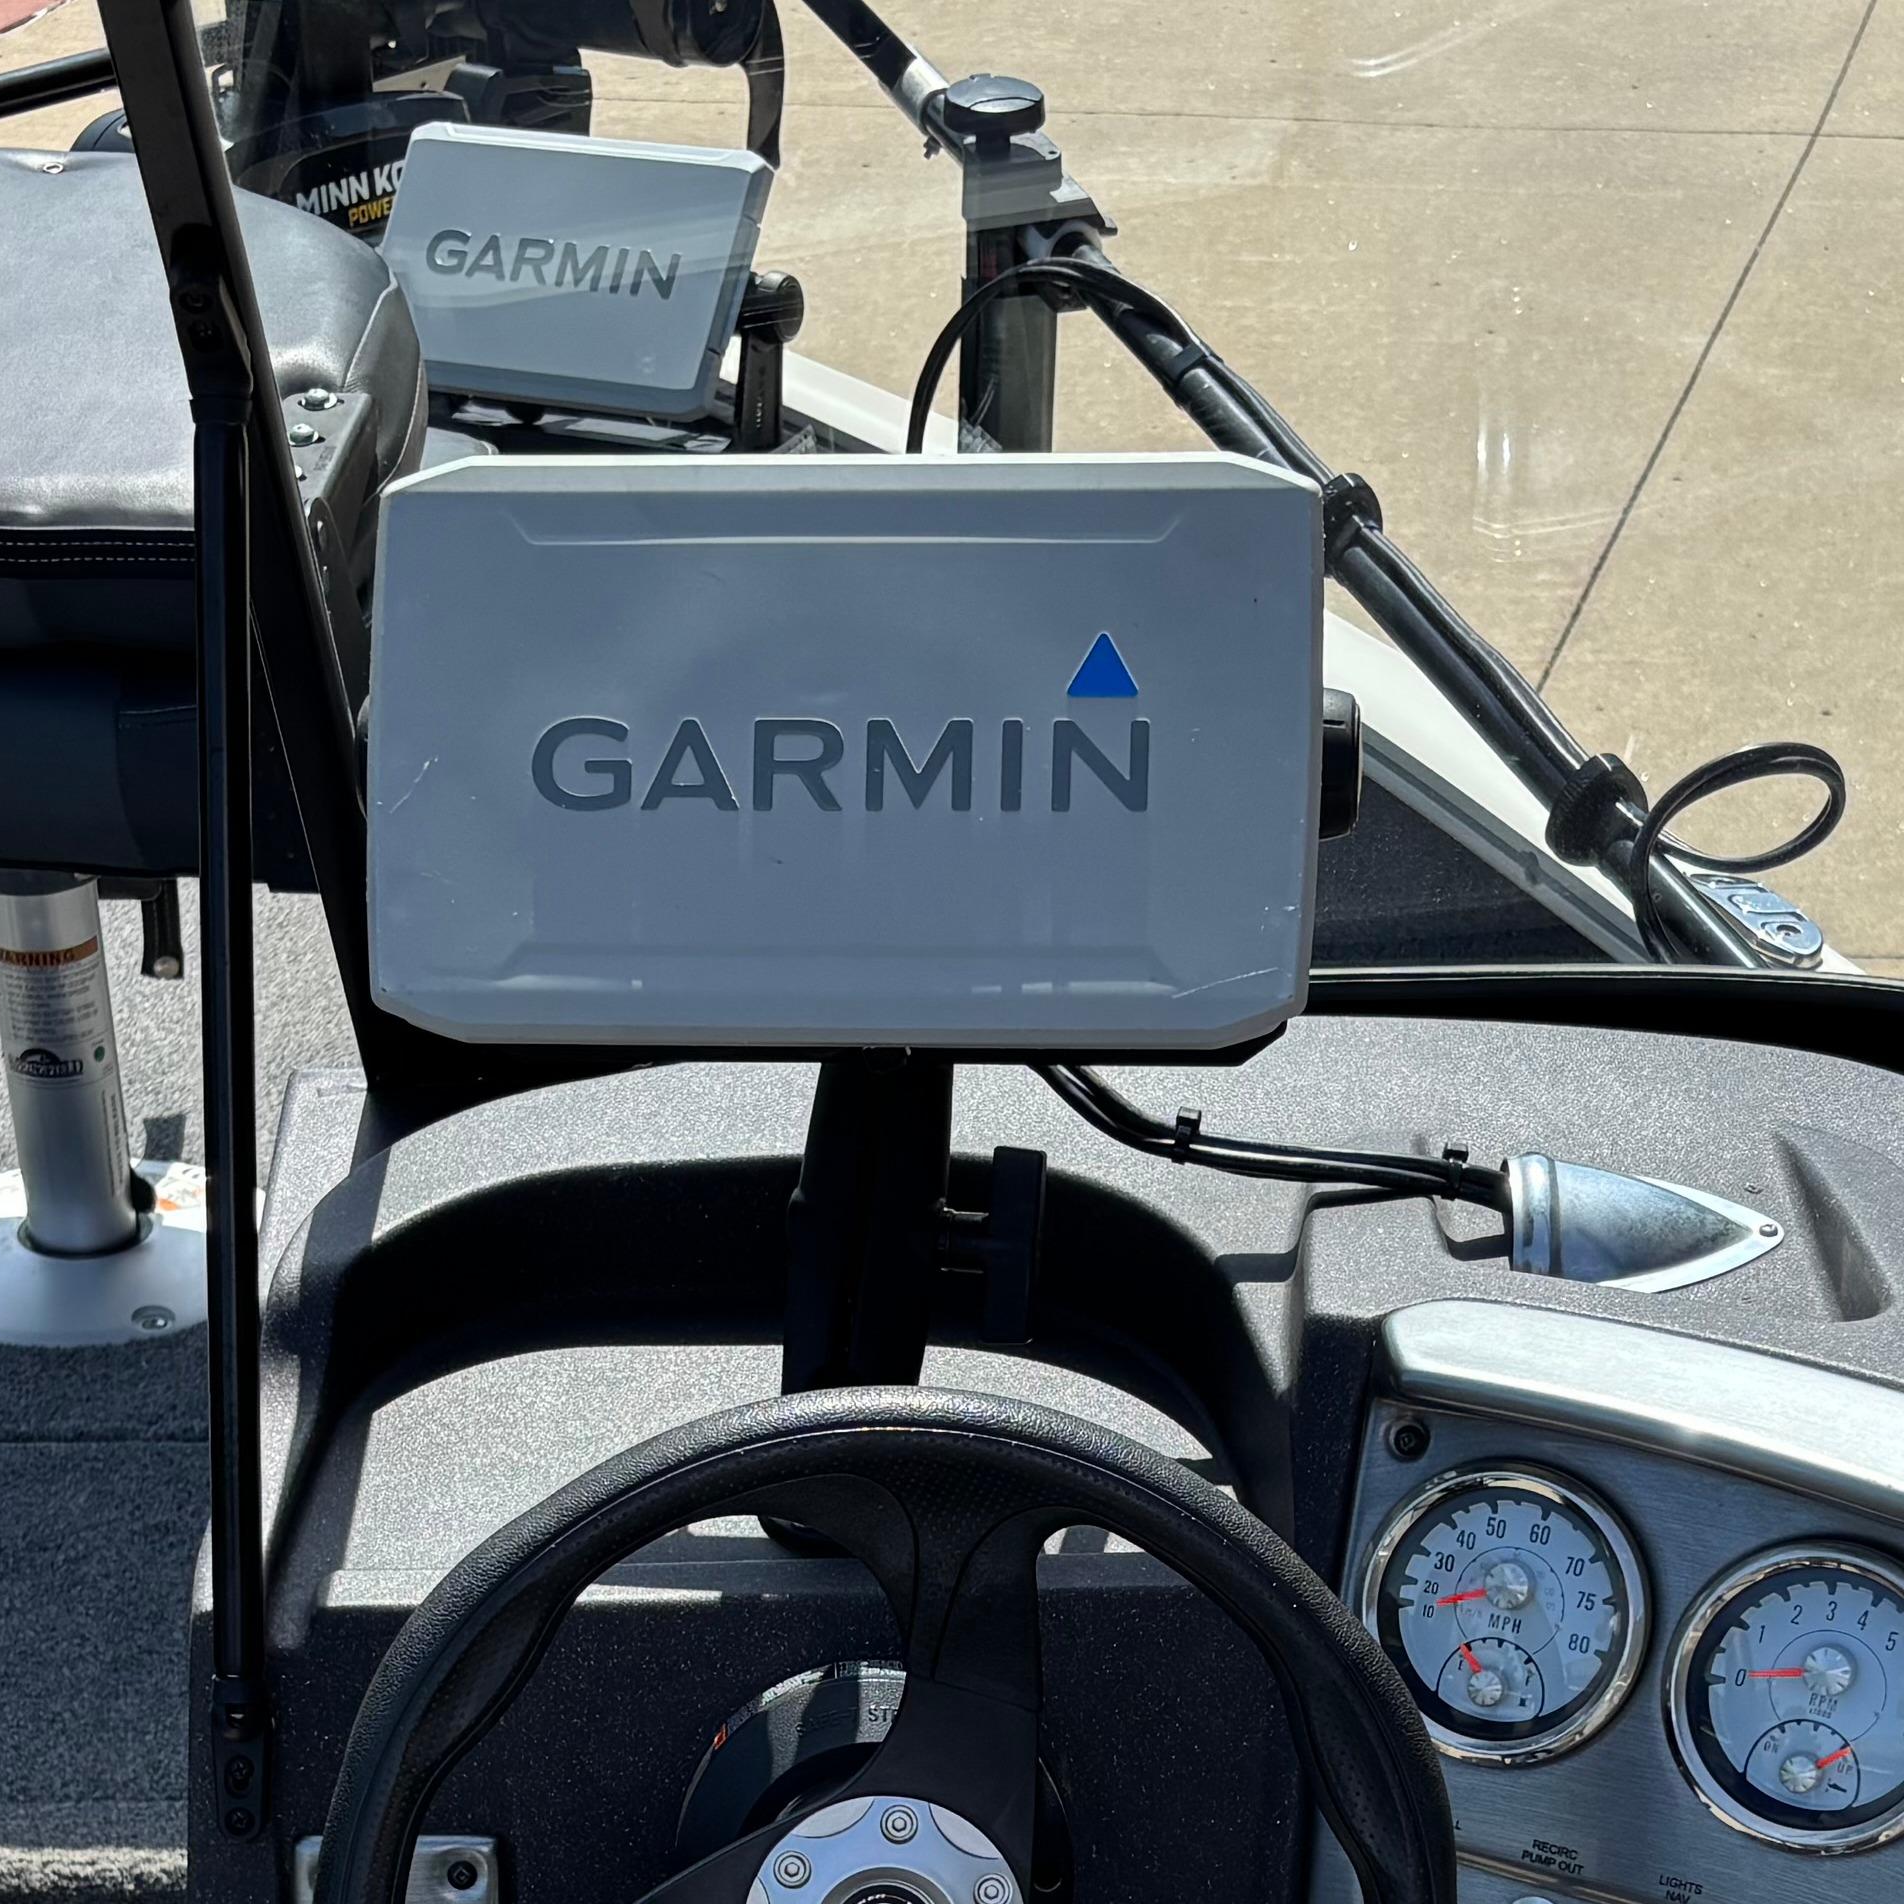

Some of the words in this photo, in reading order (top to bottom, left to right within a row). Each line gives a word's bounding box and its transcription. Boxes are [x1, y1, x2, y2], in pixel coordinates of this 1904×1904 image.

[296, 171, 370, 215] MINN
[426, 228, 683, 300] GARMIN
[530, 716, 1150, 813] GARMIN
[1486, 1517, 1506, 1538] 50
[1530, 1524, 1551, 1545] 60
[1456, 1530, 1476, 1550] 40
[1434, 1552, 1455, 1572] 30
[1565, 1557, 1585, 1576] 70
[1423, 1580, 1439, 1594] 20
[1576, 1591, 1596, 1611] 75
[1826, 1601, 1838, 1621] 3
[1422, 1604, 1435, 1619] 10
[1791, 1605, 1803, 1625] 2
[1858, 1610, 1870, 1631] 4
[1488, 1613, 1522, 1633] MPH
[1569, 1633, 1590, 1654] 80
[1759, 1625, 1766, 1643] 1
[1885, 1632, 1899, 1651] 5
[1735, 1669, 1747, 1687] 0
[1808, 1693, 1838, 1711] RPM
[1837, 1762, 1854, 1774] UP
[1532, 1838, 1578, 1862] RECIRC
[1522, 1851, 1556, 1870] PUMP
[1557, 1859, 1584, 1876] OUT
[1659, 1875, 1703, 1896] LIGHTS
[1665, 1888, 1692, 1904] NAV
